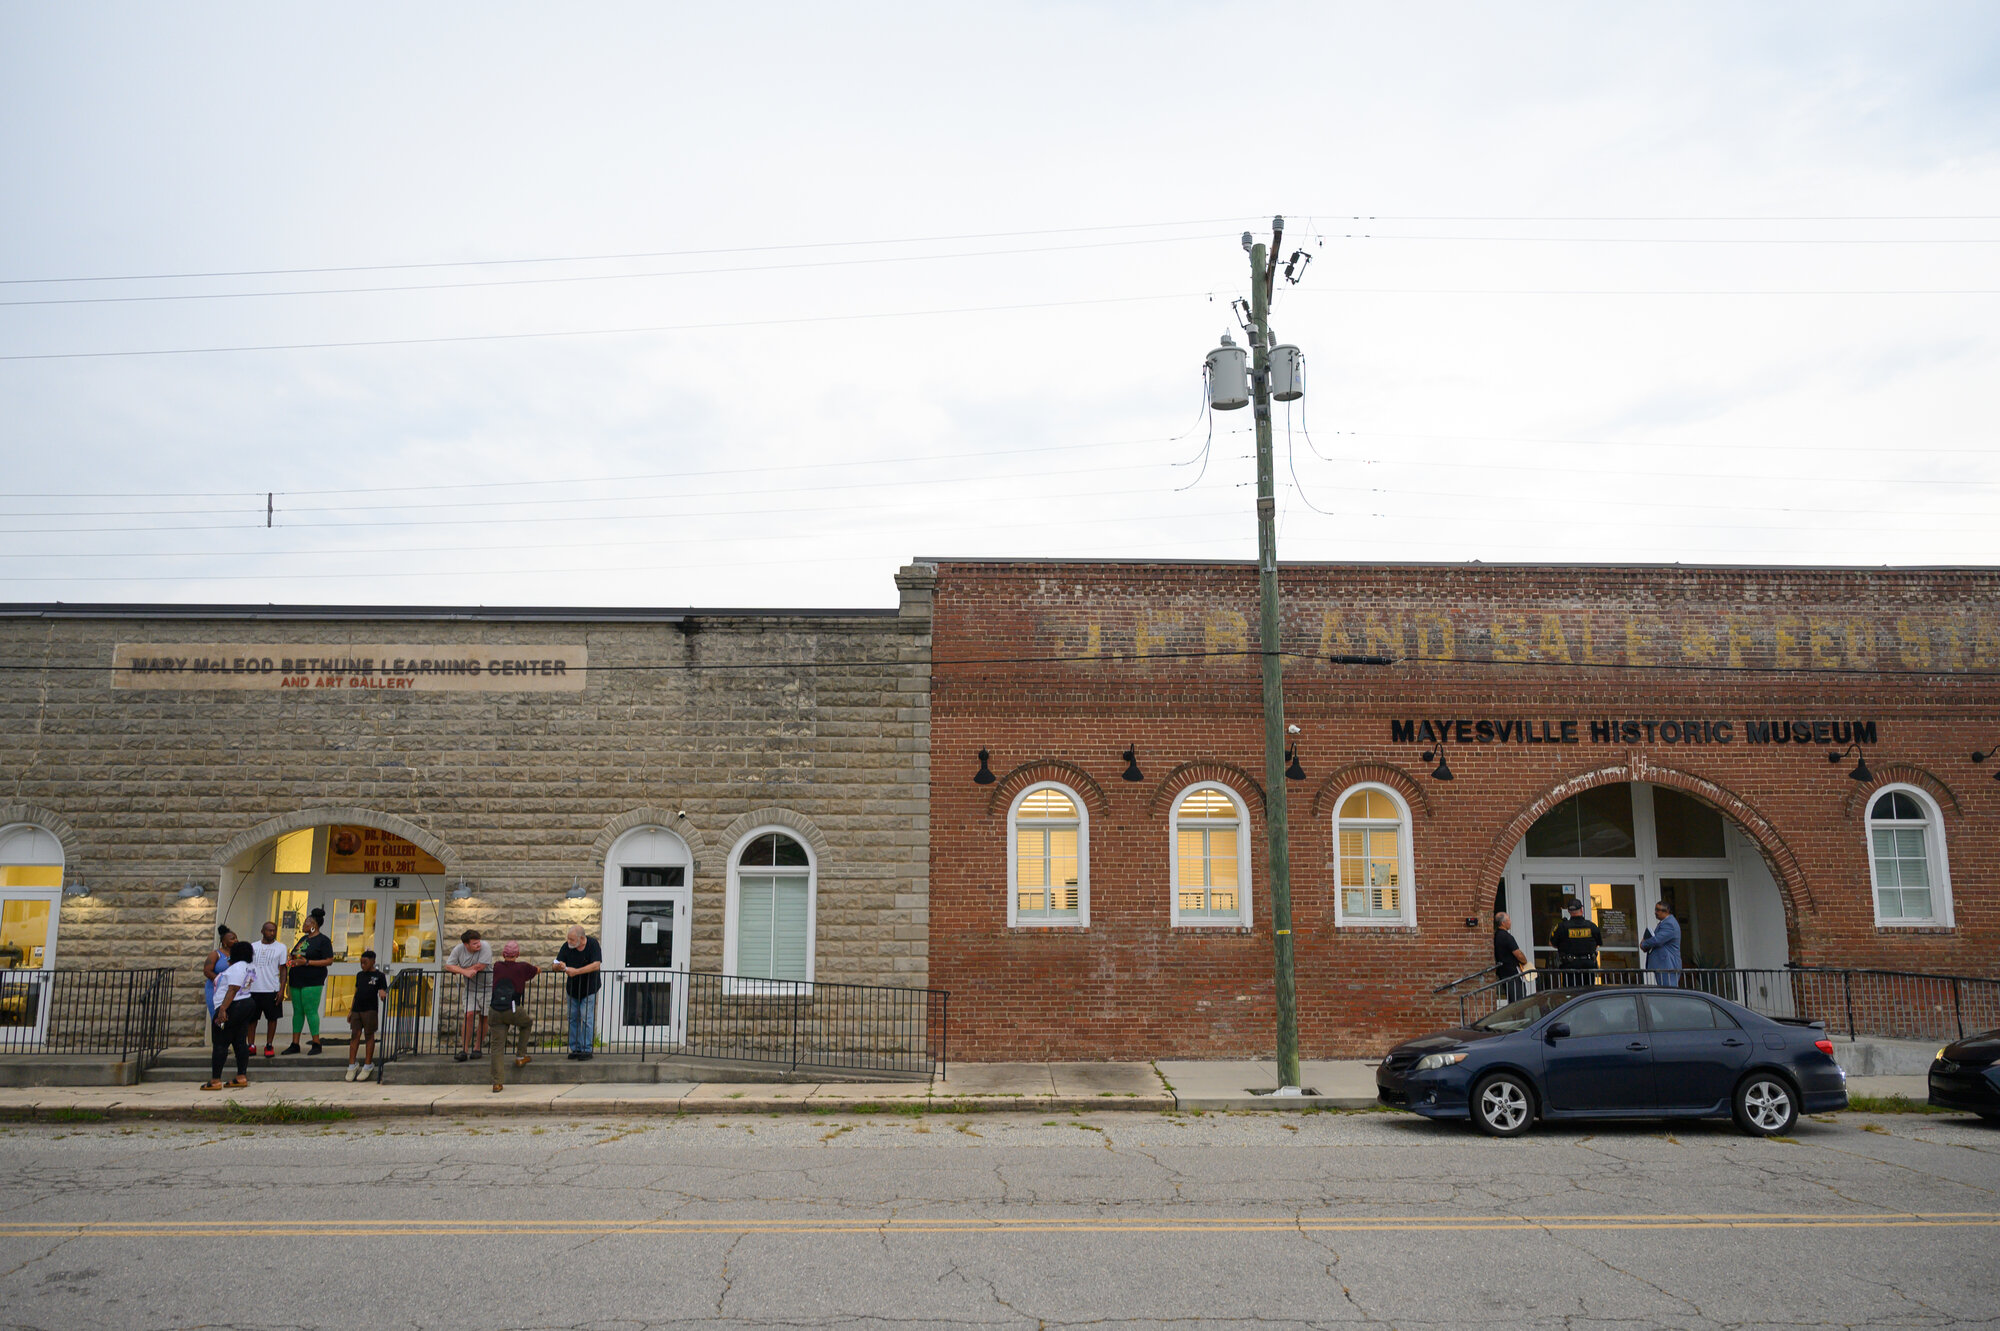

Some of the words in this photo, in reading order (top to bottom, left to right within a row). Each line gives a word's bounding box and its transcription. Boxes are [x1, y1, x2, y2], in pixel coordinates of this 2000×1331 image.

[131, 657, 188, 675] MARY
[193, 657, 274, 675] McLEOD
[281, 658, 374, 675] BETHUNE
[381, 659, 481, 676] LEARNING
[488, 660, 567, 676] CENTER
[281, 677, 310, 688] AND
[315, 677, 344, 688] ART
[349, 677, 415, 689] GALLERY
[1391, 719, 1579, 744] MAYESVILLE
[1590, 719, 1734, 744] HISTORIC
[1746, 720, 1878, 744] MUSEUM
[364, 845, 380, 857] ART
[382, 845, 417, 857] GALLERY
[364, 860, 379, 872] MAY
[382, 860, 394, 874] 19,
[396, 860, 416, 872] 2017
[379, 878, 394, 887] 35
